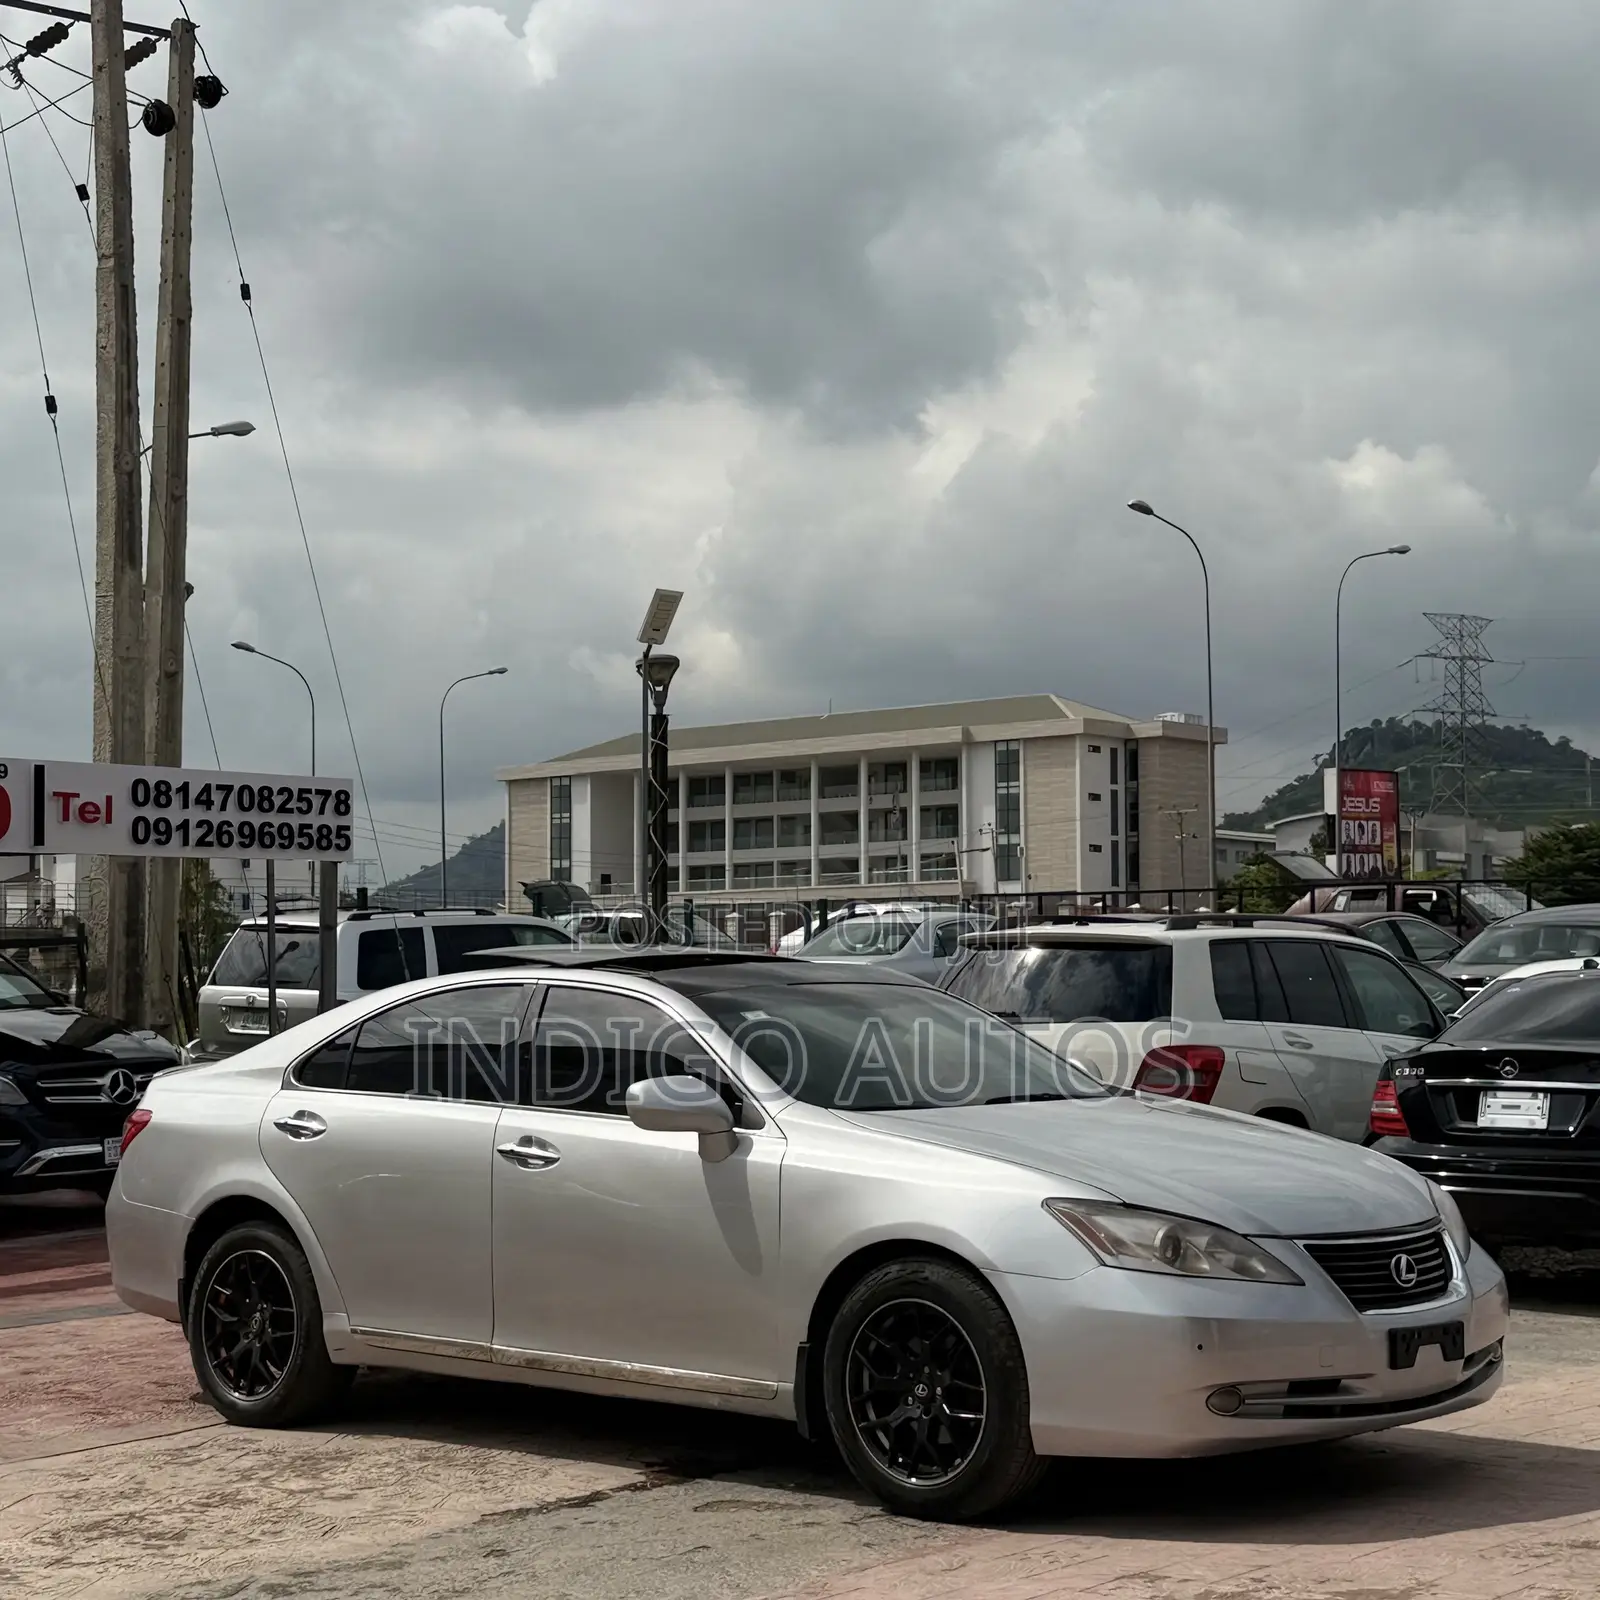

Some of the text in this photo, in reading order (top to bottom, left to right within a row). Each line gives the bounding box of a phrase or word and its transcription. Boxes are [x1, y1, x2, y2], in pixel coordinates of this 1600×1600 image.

[53, 791, 113, 825] Tel
[131, 778, 351, 817] 08147082578
[131, 815, 351, 851] 09126969585
